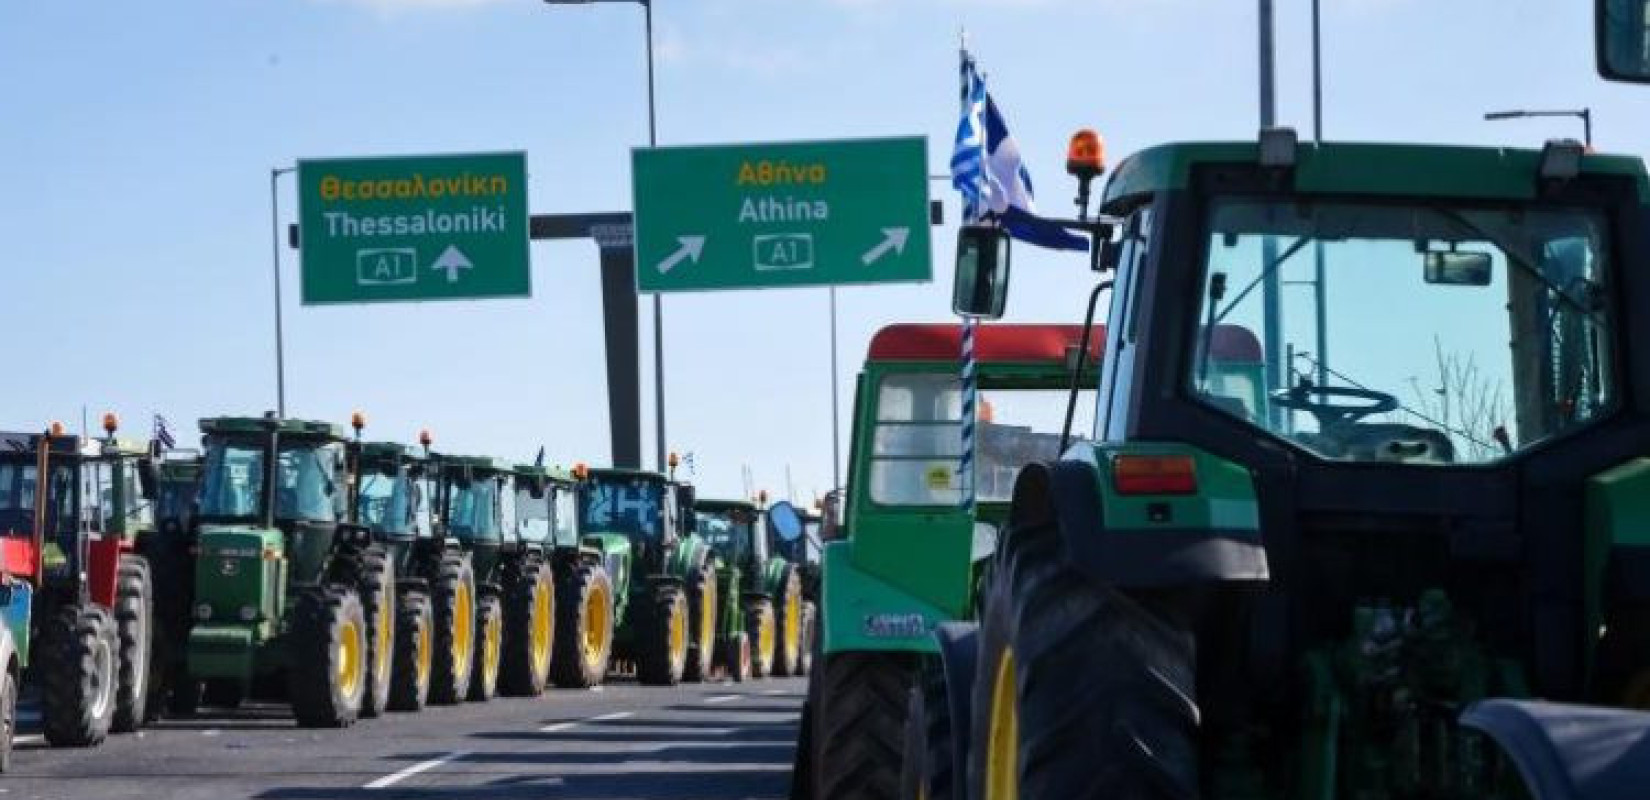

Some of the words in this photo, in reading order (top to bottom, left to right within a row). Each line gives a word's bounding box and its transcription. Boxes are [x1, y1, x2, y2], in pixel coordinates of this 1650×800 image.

[737, 161, 827, 186] Αθήνα
[320, 172, 507, 202] Θεσσαλονίκη
[322, 207, 506, 237] Thessaloniki
[738, 195, 829, 223] Athina
[771, 241, 798, 263] A1
[374, 255, 401, 279] A1
